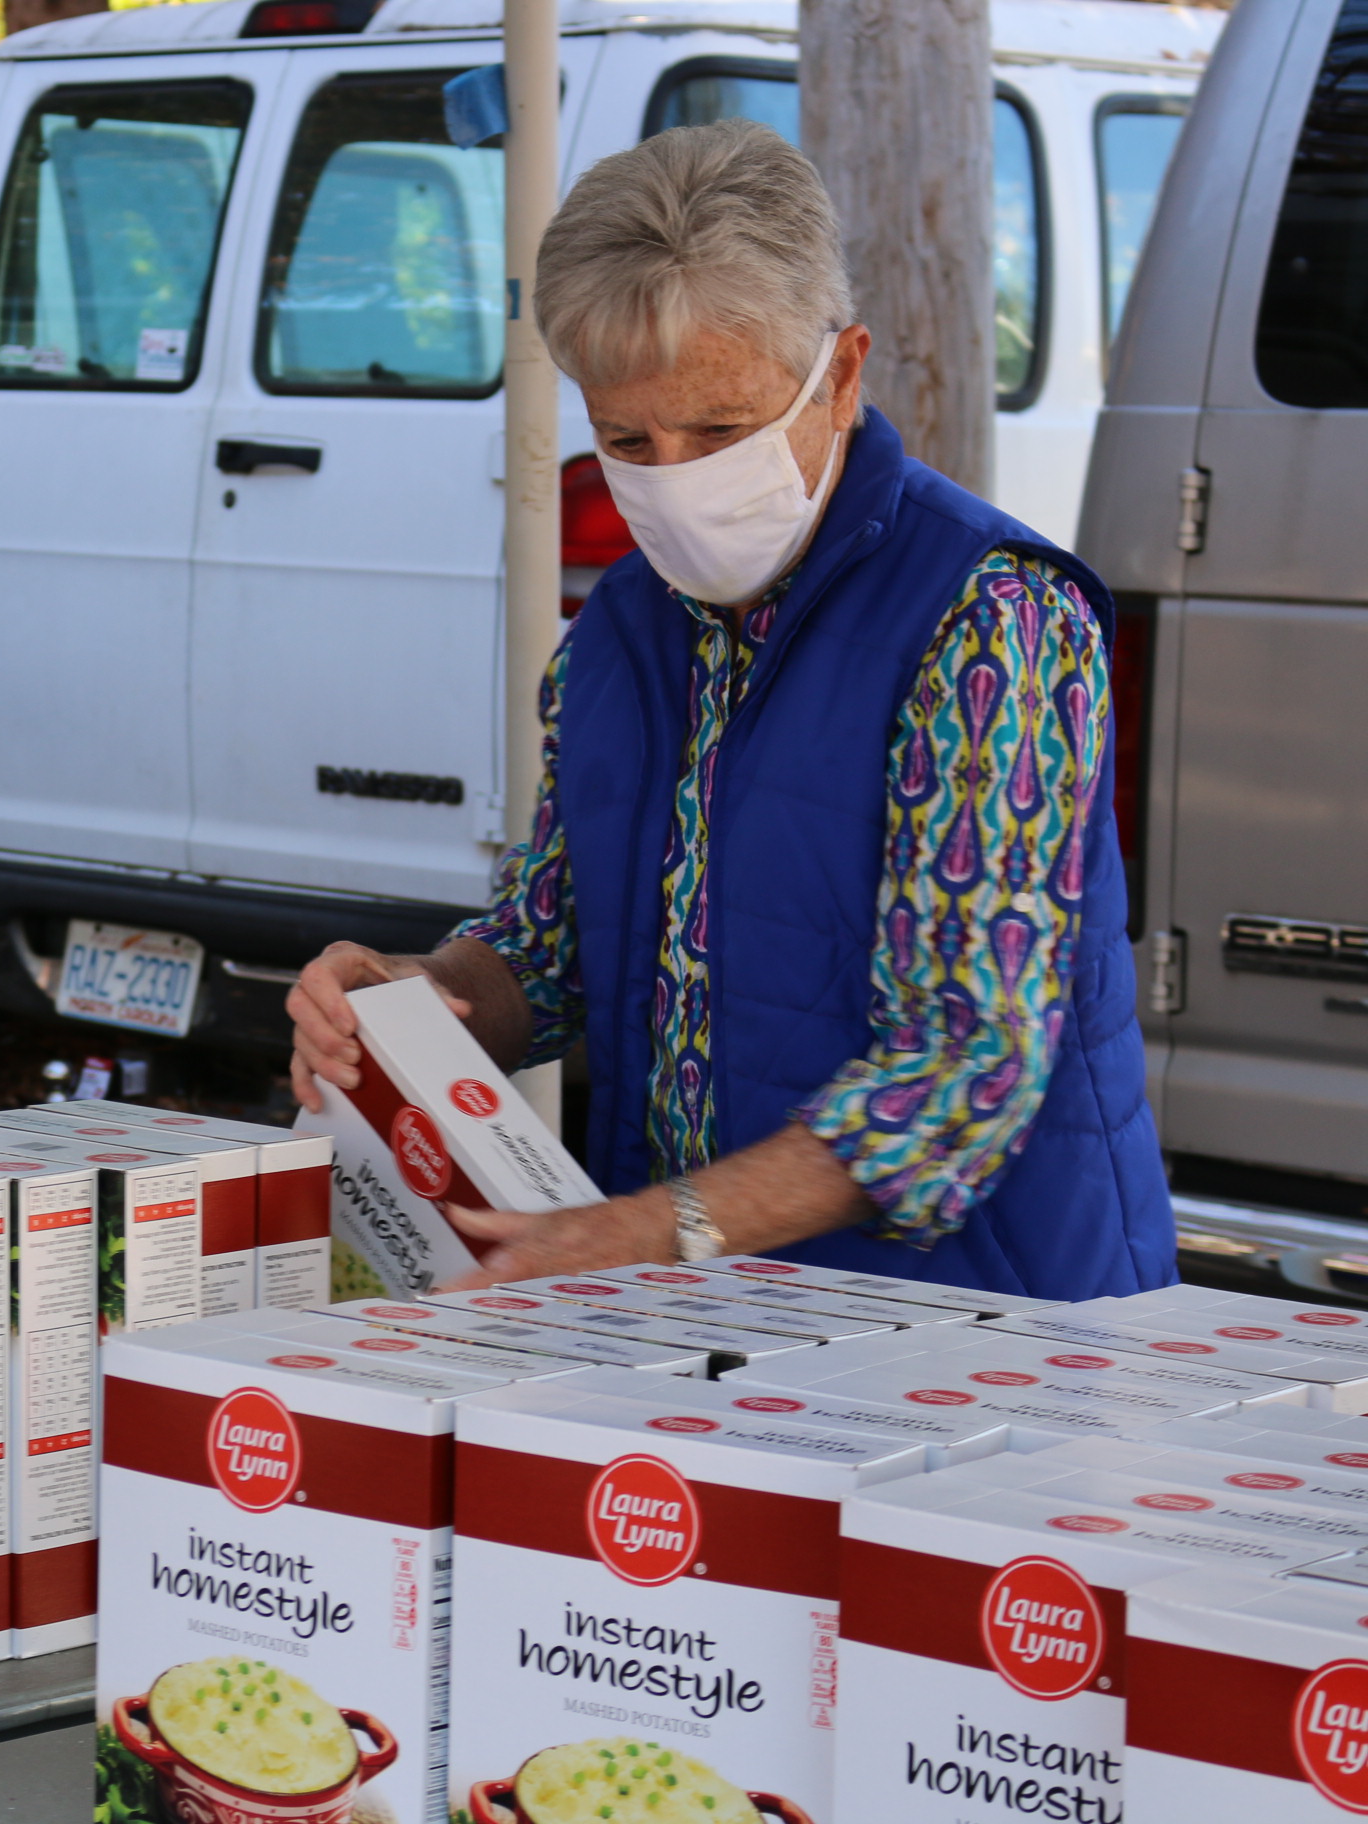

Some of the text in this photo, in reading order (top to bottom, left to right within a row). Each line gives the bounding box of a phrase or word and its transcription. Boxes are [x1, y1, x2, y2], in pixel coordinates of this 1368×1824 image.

[216, 1414, 286, 1452] Laura
[229, 1446, 288, 1481] Lynn
[598, 1482, 682, 1522] Laura
[189, 1527, 315, 1584] instant
[612, 1516, 685, 1553] Lynn
[152, 1552, 355, 1639] homestyle
[993, 1586, 1085, 1631] Laura
[187, 1618, 310, 1658] MASHED POTATOES
[565, 1601, 717, 1661] instant
[1009, 1622, 1088, 1664] Lynn
[519, 1628, 765, 1719] homestyle
[563, 1697, 712, 1739] MASHED POTATOES
[957, 1714, 1122, 1785] instant
